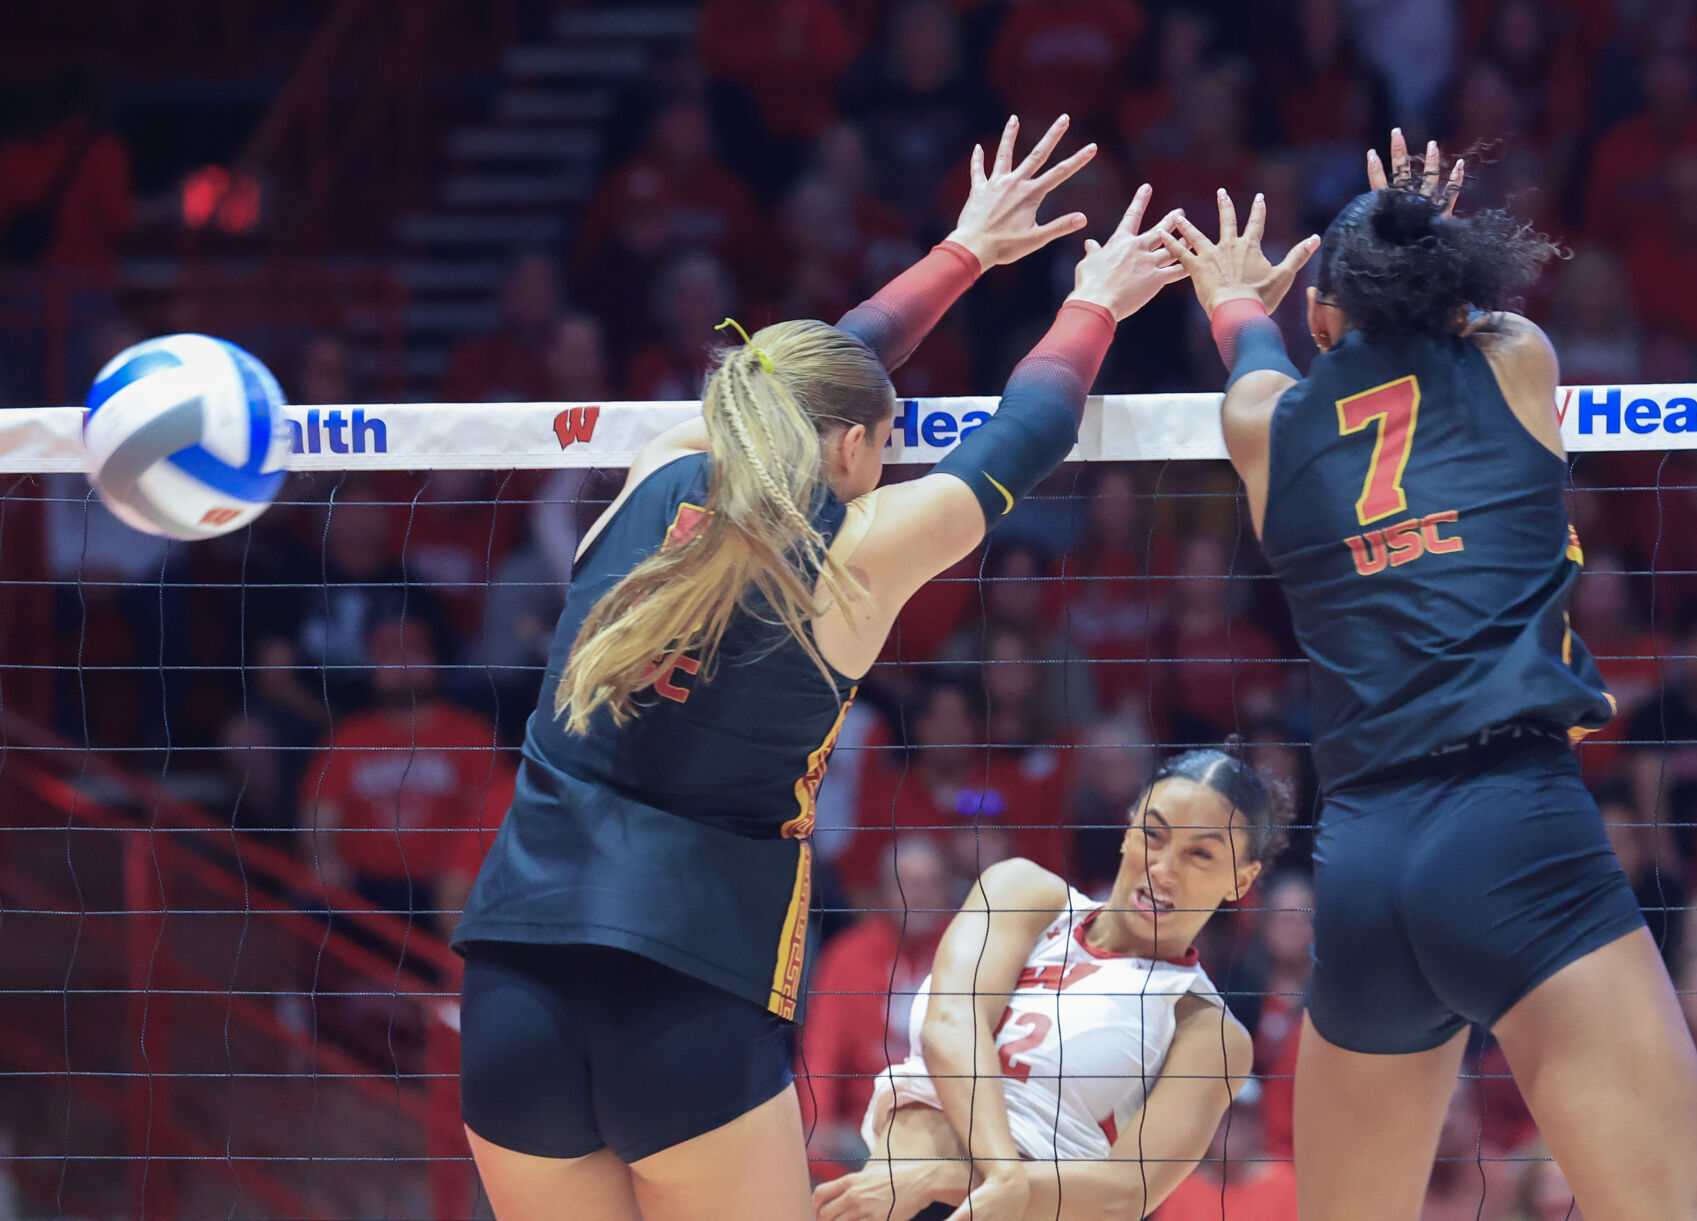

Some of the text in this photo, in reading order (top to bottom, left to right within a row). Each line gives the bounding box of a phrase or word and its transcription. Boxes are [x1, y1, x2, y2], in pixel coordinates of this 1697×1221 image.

[553, 405, 600, 451] W
[884, 401, 995, 448] Hea
[1335, 374, 1421, 526] 7
[1344, 510, 1464, 576] USC
[993, 1005, 1053, 1084] 2
